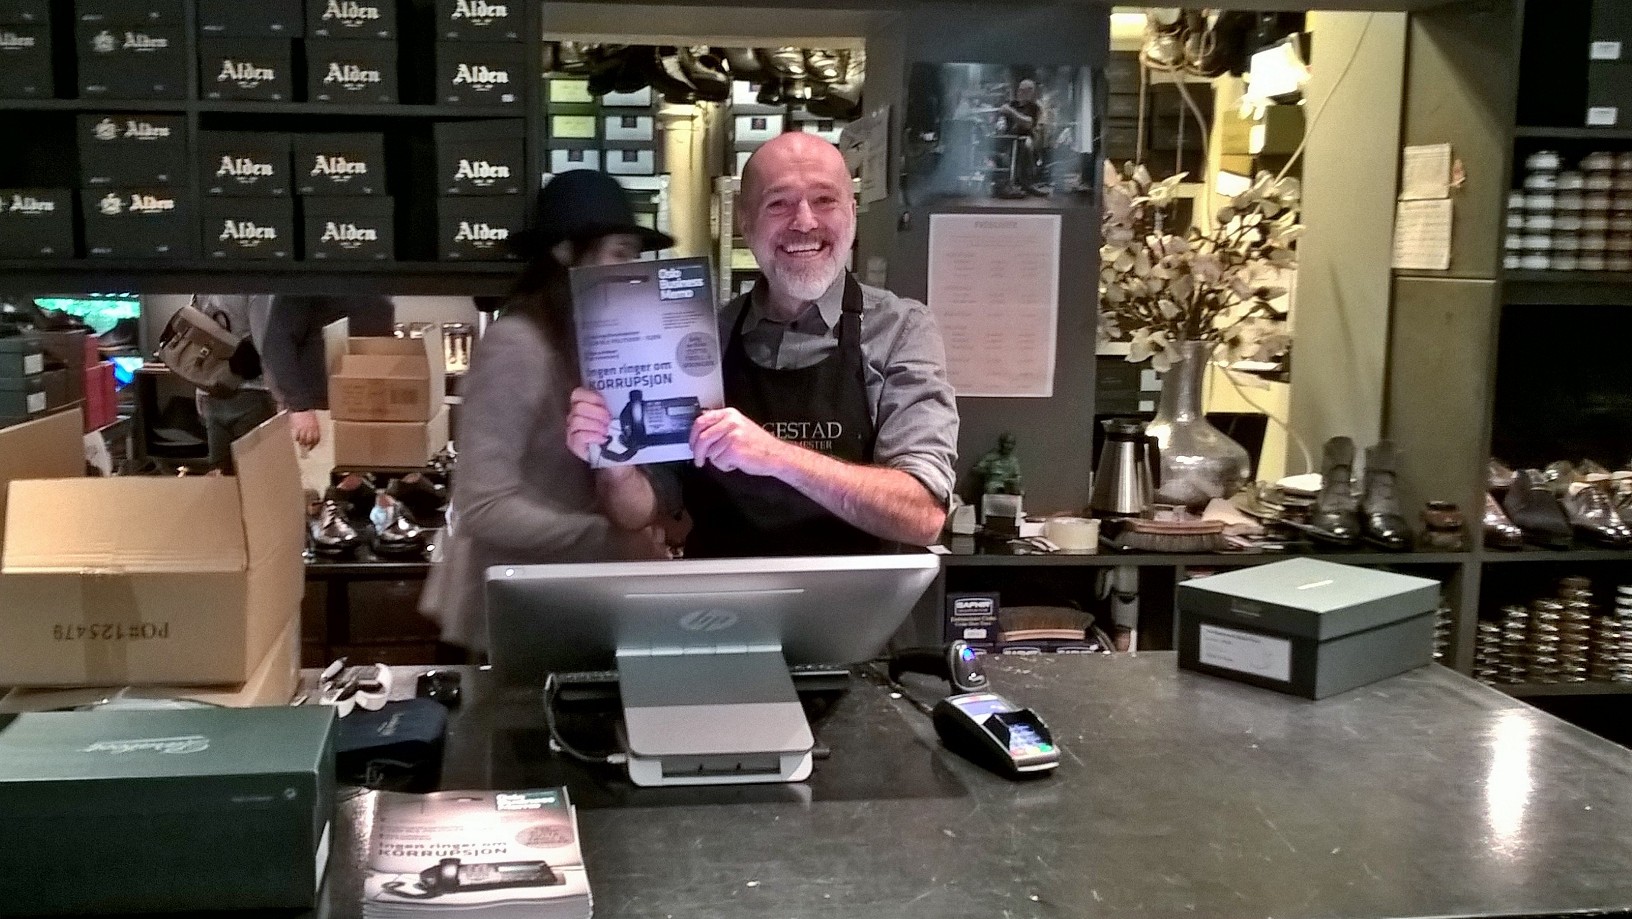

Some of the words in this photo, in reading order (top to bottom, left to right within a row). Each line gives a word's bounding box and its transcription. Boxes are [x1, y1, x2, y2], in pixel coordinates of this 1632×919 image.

[321, 0, 380, 20] Alden
[449, 0, 508, 19] Alden
[0, 32, 35, 46] lden
[217, 59, 275, 81] Alden
[323, 62, 380, 84] Alden
[452, 63, 509, 85] Alden
[216, 155, 274, 177] Alden
[310, 155, 367, 177] Alden
[454, 159, 510, 181] Alden
[219, 219, 277, 241] Alden
[321, 221, 378, 243] Alden
[454, 221, 509, 242] Alden
[619, 363, 651, 376] ringer
[653, 361, 673, 371] om
[588, 372, 673, 391] KORRUPSJON
[378, 847, 508, 858] KORRUPSJON
